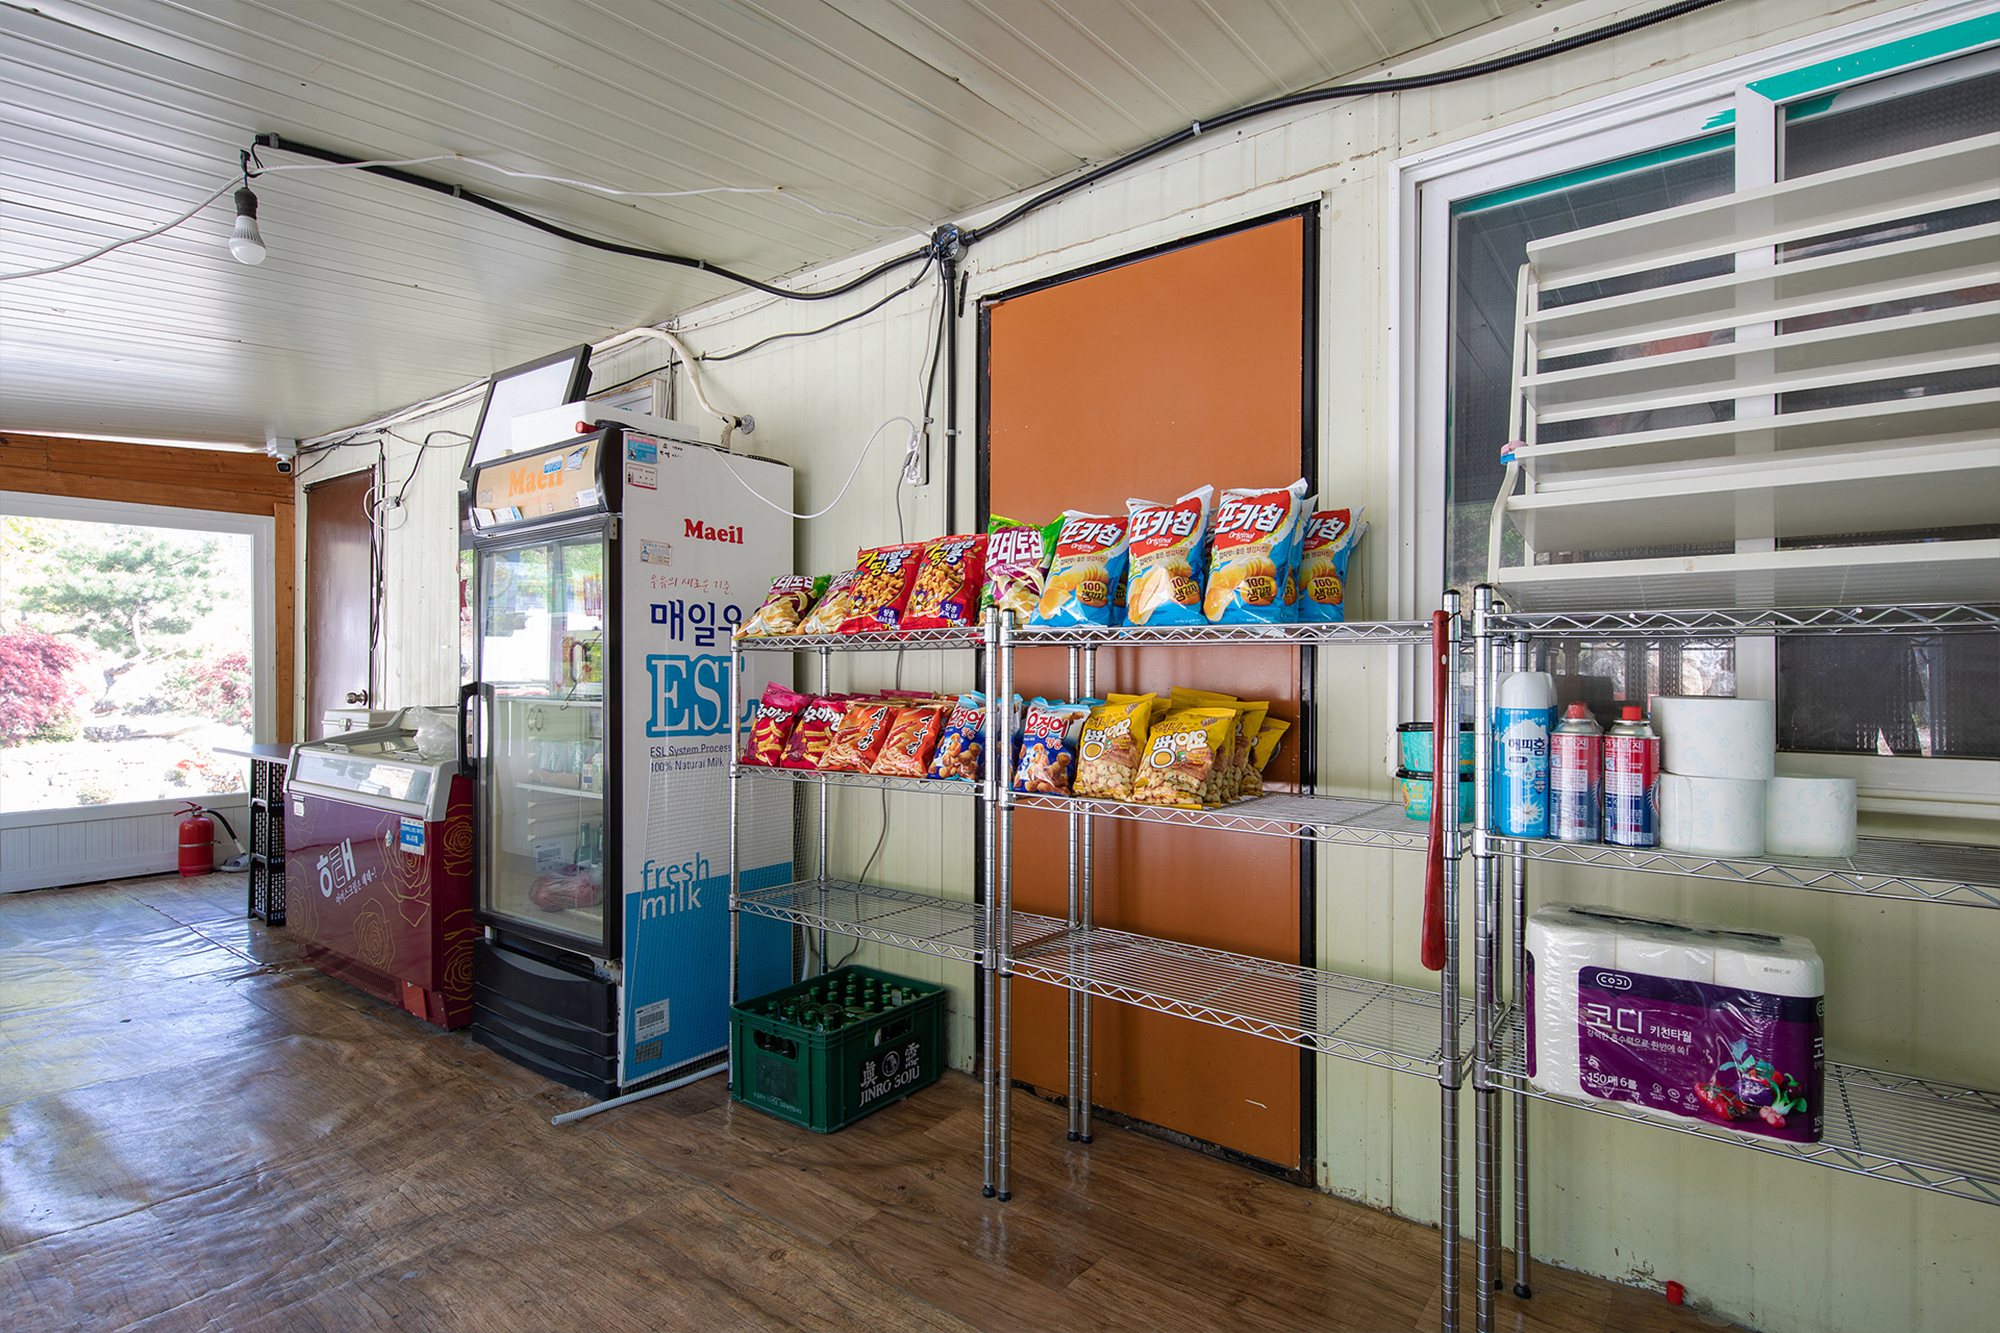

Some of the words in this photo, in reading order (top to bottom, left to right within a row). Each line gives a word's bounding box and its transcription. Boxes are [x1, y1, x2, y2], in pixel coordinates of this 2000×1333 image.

[684, 518, 744, 544] Maeil
[1129, 509, 1198, 544] 포카칩
[1215, 503, 1286, 534] 포카칩
[1057, 520, 1123, 548] 포카칩
[985, 530, 1044, 571] 포테토칩
[651, 574, 677, 589] 우유의
[681, 578, 709, 593] 새로운
[1173, 584, 1198, 602] 생감자
[1247, 586, 1271, 602] 생감자
[1314, 587, 1340, 600] 생감자
[650, 599, 742, 646] 매일우
[650, 657, 757, 733] ESL
[858, 706, 888, 751] 새우깡
[1024, 712, 1070, 739] 오징어
[650, 747, 667, 758] ESL
[668, 744, 699, 758] System
[1046, 737, 1063, 750] 땅콩
[1508, 737, 1546, 757] 해피홈
[651, 762, 672, 773] 100%
[675, 759, 705, 771] Natural
[707, 757, 724, 768] Milk
[641, 852, 710, 891] fresh
[642, 881, 702, 920] milk
[1600, 976, 1628, 987] CODI
[1586, 1003, 1642, 1034] 코디
[1650, 1025, 1692, 1043] 키친타월
[1651, 1041, 1675, 1053] 한번에
[858, 1079, 892, 1108] JINRO
[893, 1065, 920, 1088] SOJU
[1587, 1072, 1618, 1086] 150매
